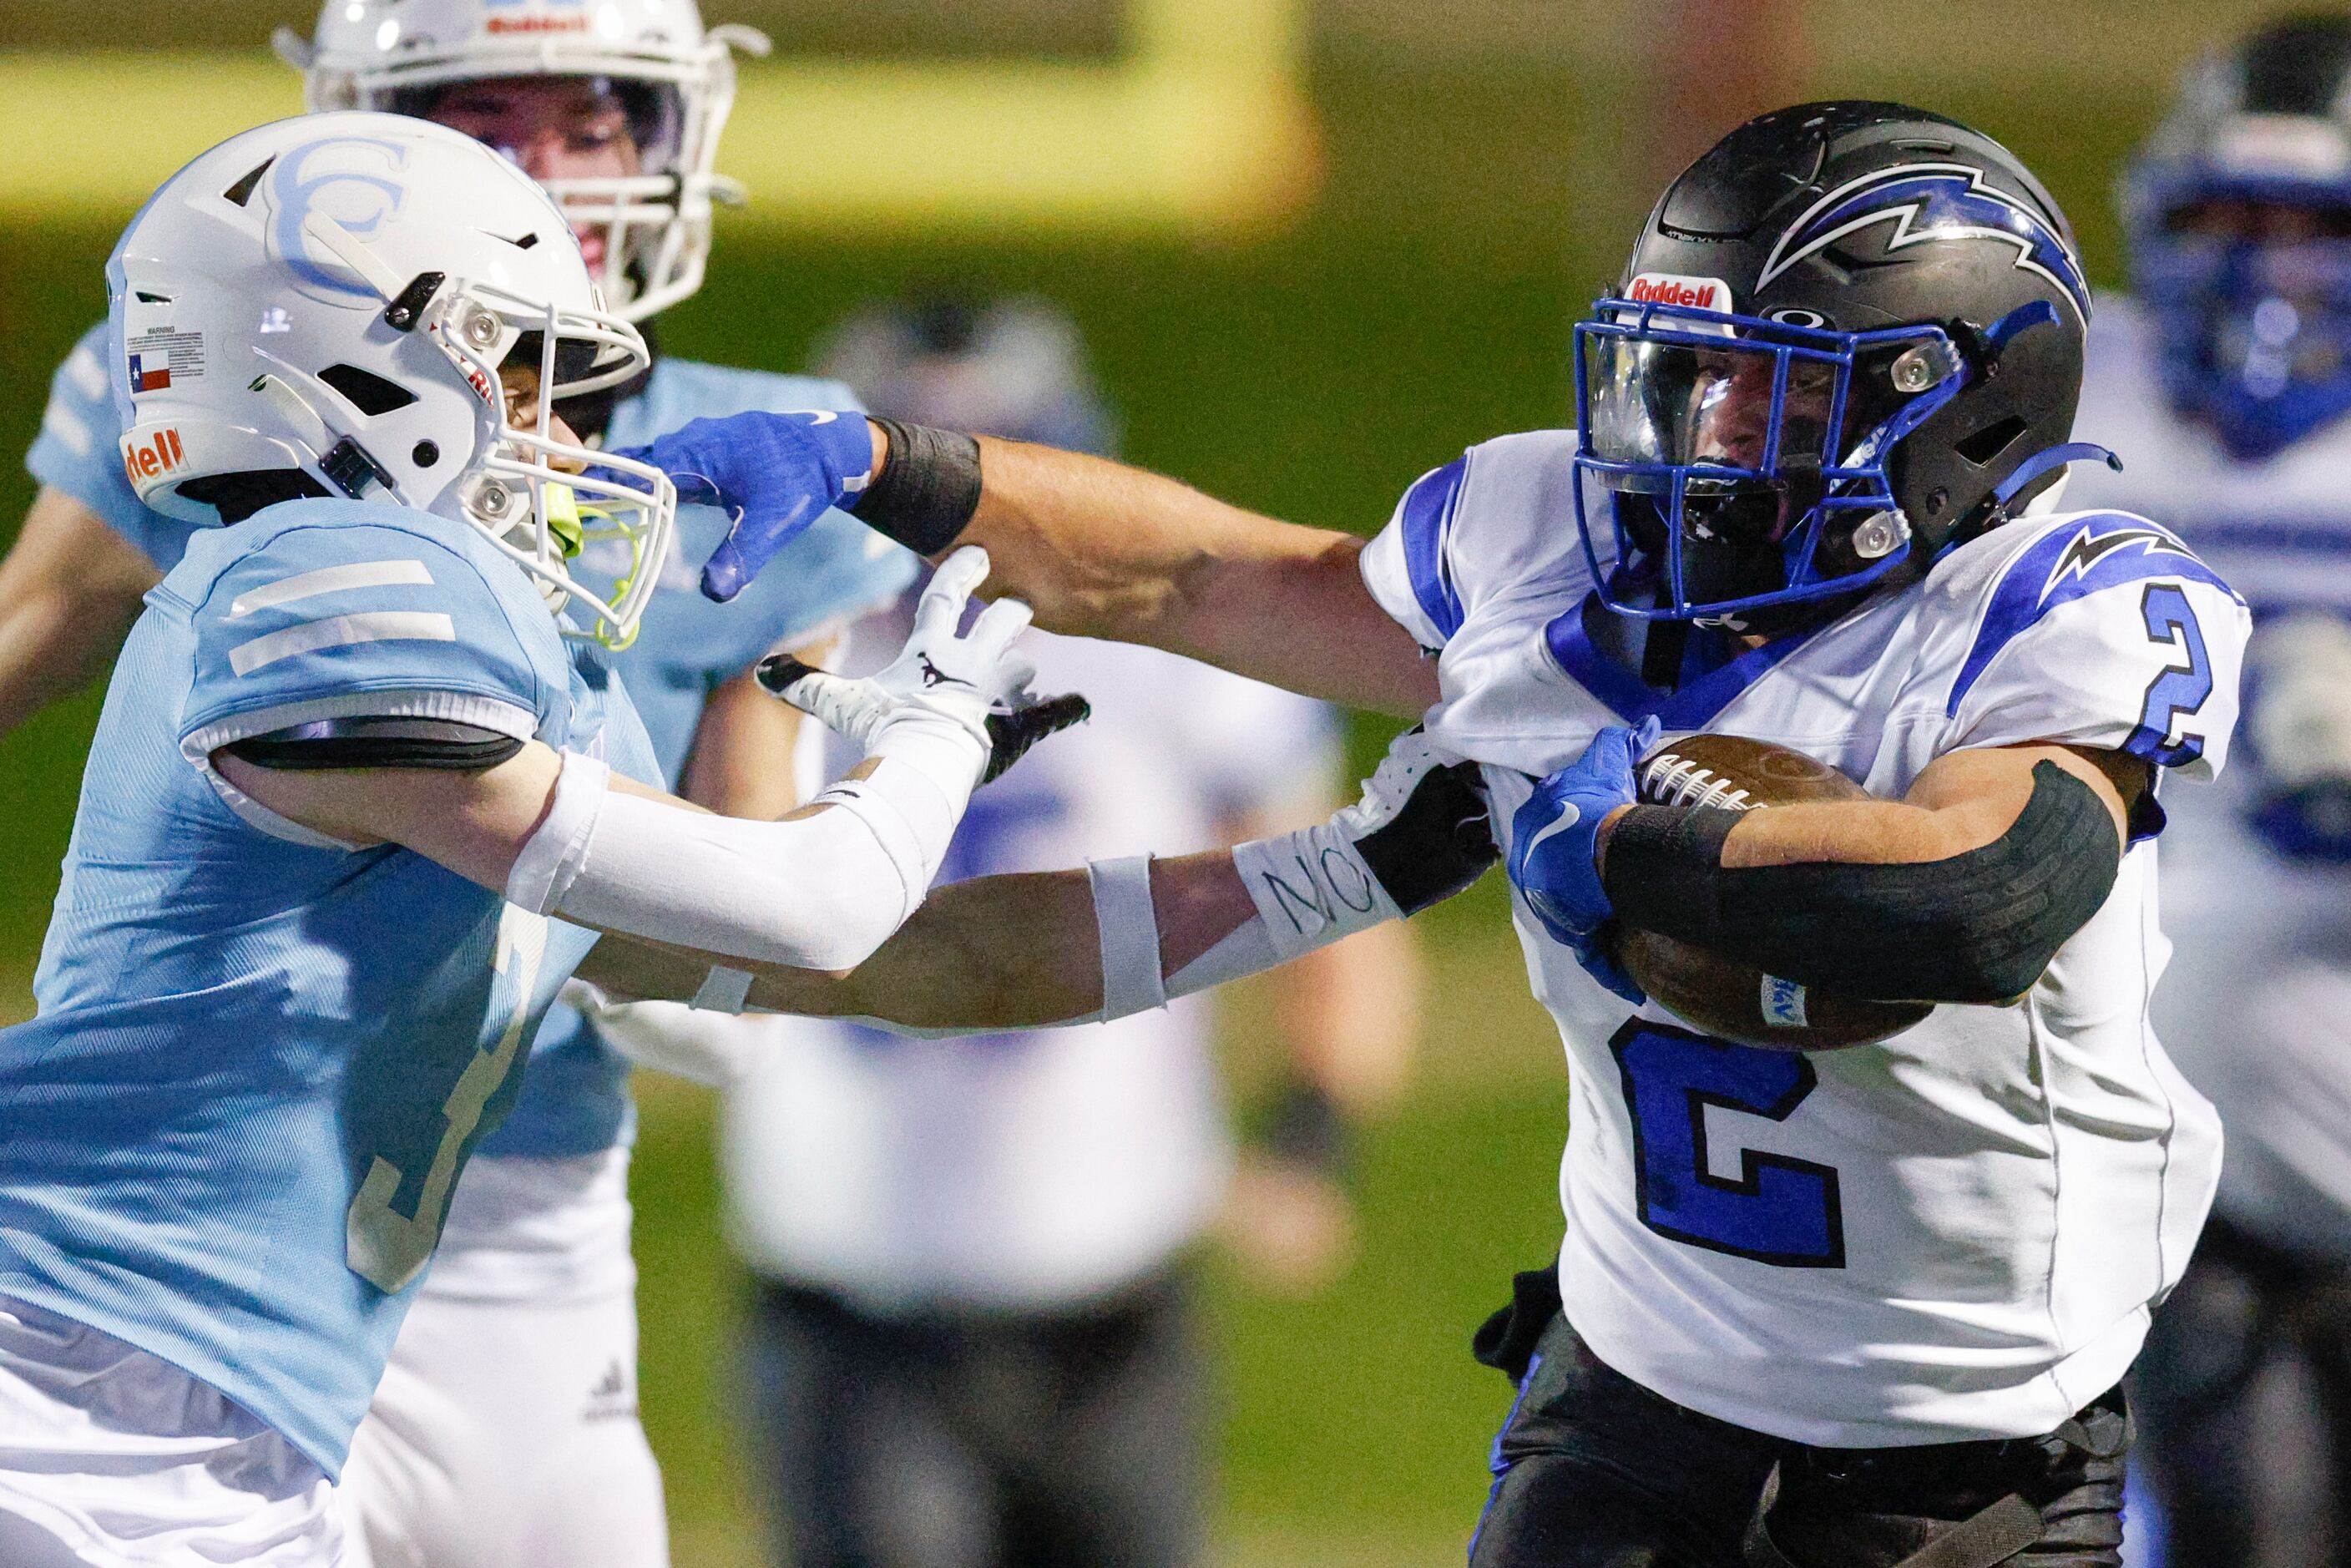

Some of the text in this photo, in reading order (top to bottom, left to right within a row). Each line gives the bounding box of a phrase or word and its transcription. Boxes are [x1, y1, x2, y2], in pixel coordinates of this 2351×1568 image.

[1631, 279, 1716, 308] Riddell
[147, 326, 175, 335] WARNING
[2119, 583, 2212, 767] 2
[1261, 847, 1373, 934] NO
